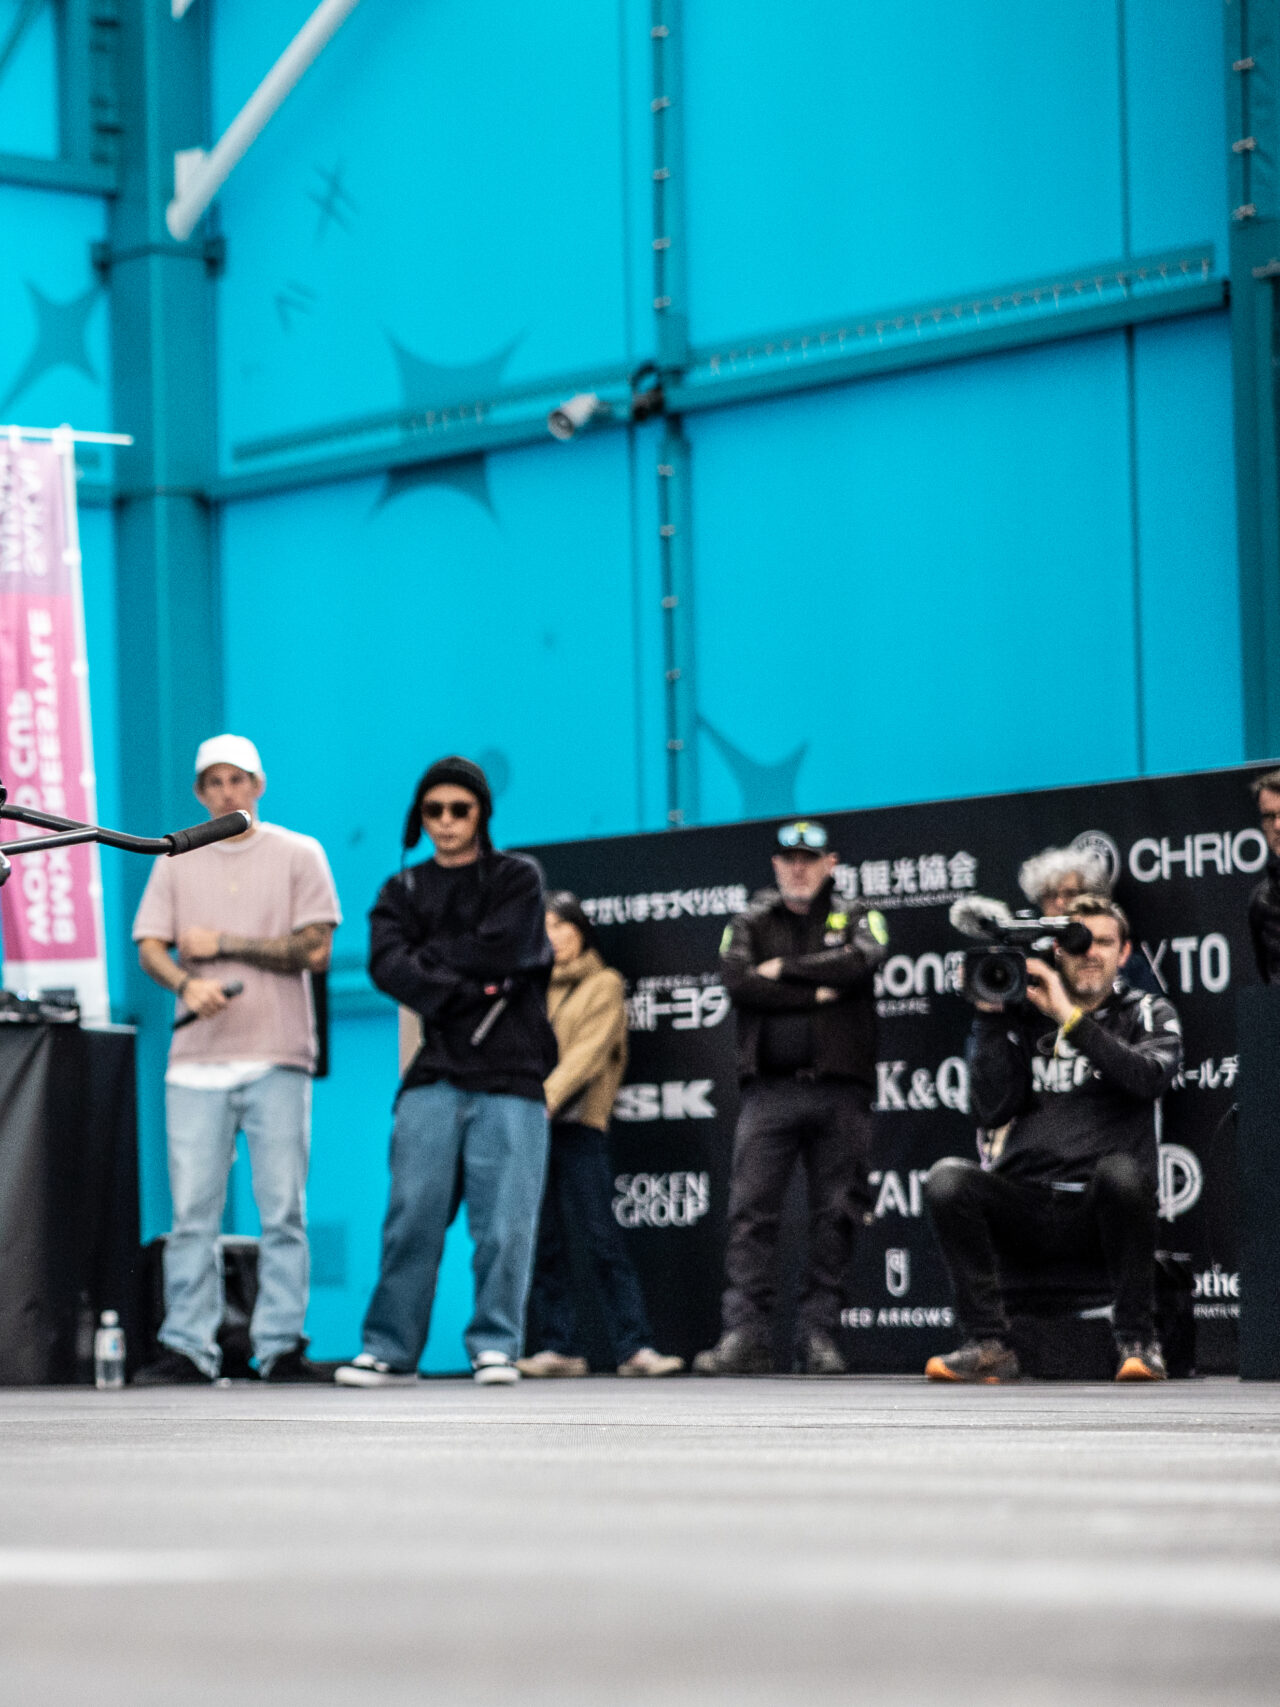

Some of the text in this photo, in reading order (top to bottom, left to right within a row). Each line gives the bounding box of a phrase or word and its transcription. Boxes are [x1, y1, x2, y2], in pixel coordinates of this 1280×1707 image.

[1128, 828, 1269, 883] CHRIO
[873, 1056, 970, 1114] K&Q
[614, 1171, 710, 1201] SOKEN
[612, 1196, 710, 1228] GROUP
[877, 1306, 955, 1328] ARROWS
